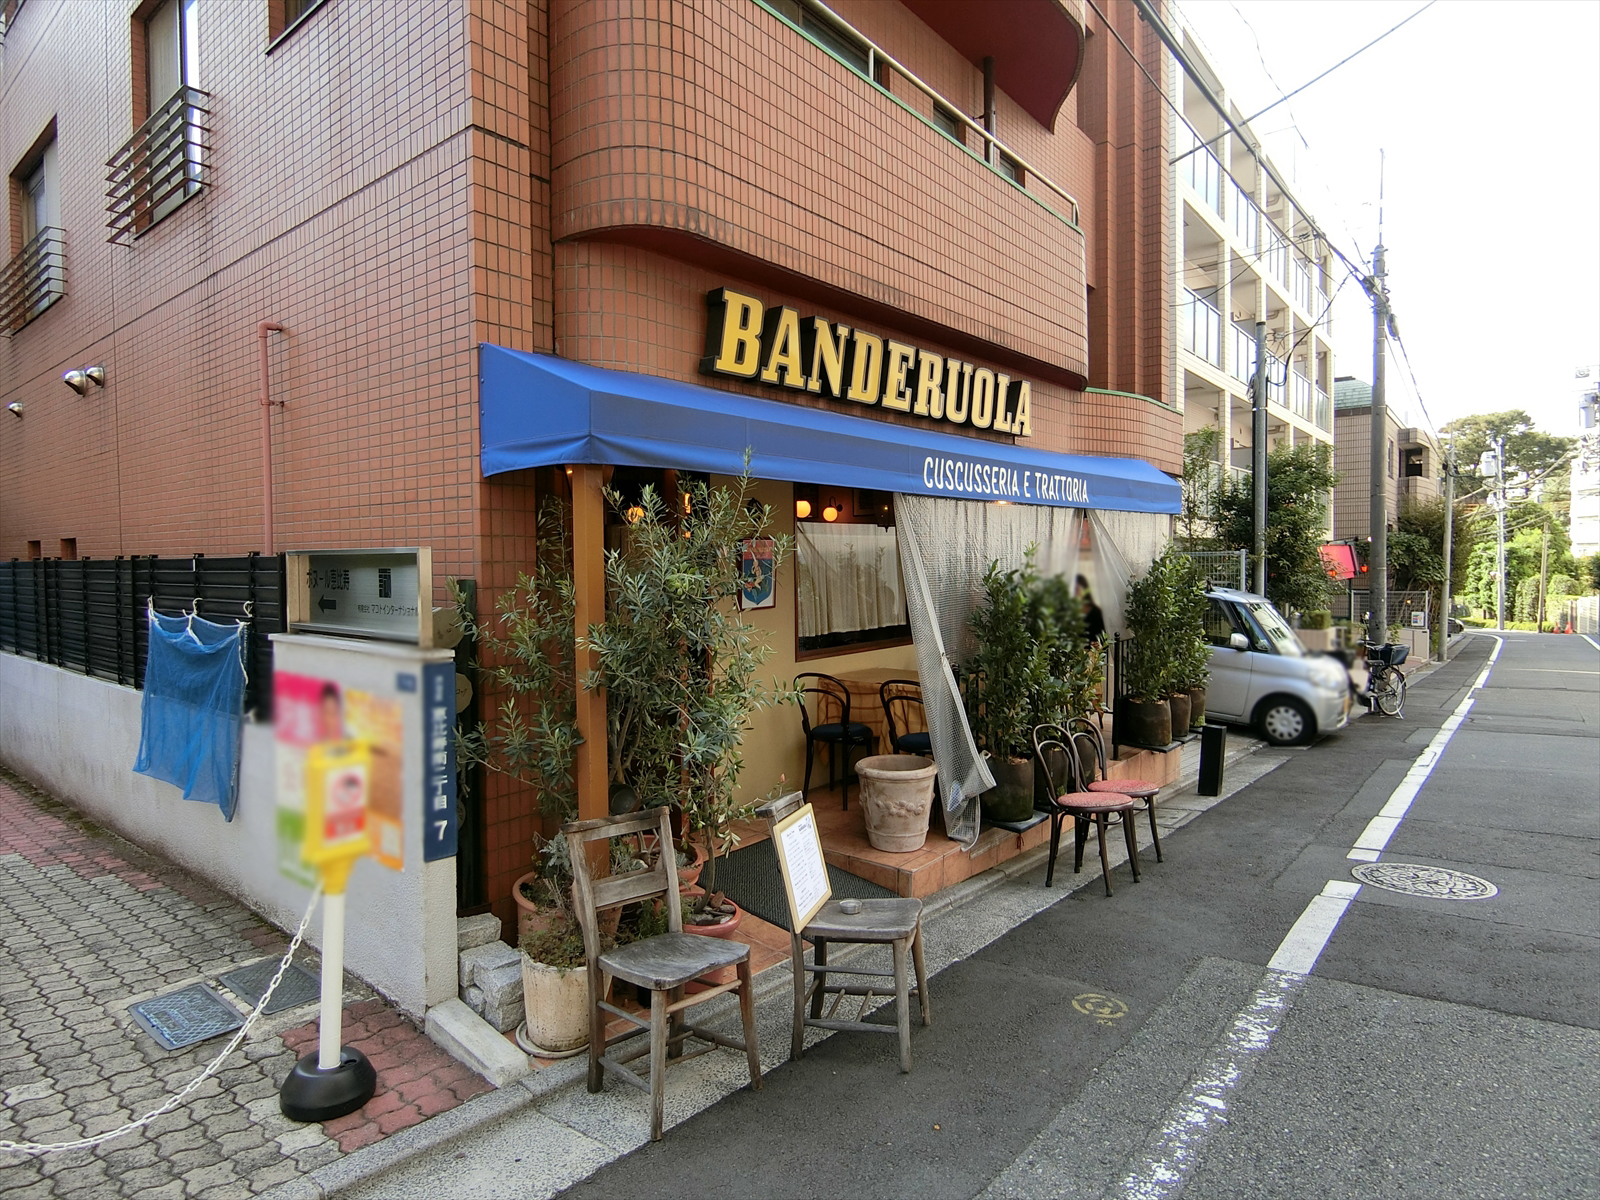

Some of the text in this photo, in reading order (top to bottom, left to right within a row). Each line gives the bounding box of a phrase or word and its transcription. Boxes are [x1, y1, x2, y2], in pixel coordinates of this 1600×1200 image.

[712, 288, 1032, 437] BANDERUOLA
[923, 456, 1089, 503] CUSCUSSERIA E TRATTORIA
[433, 819, 448, 841] 7
